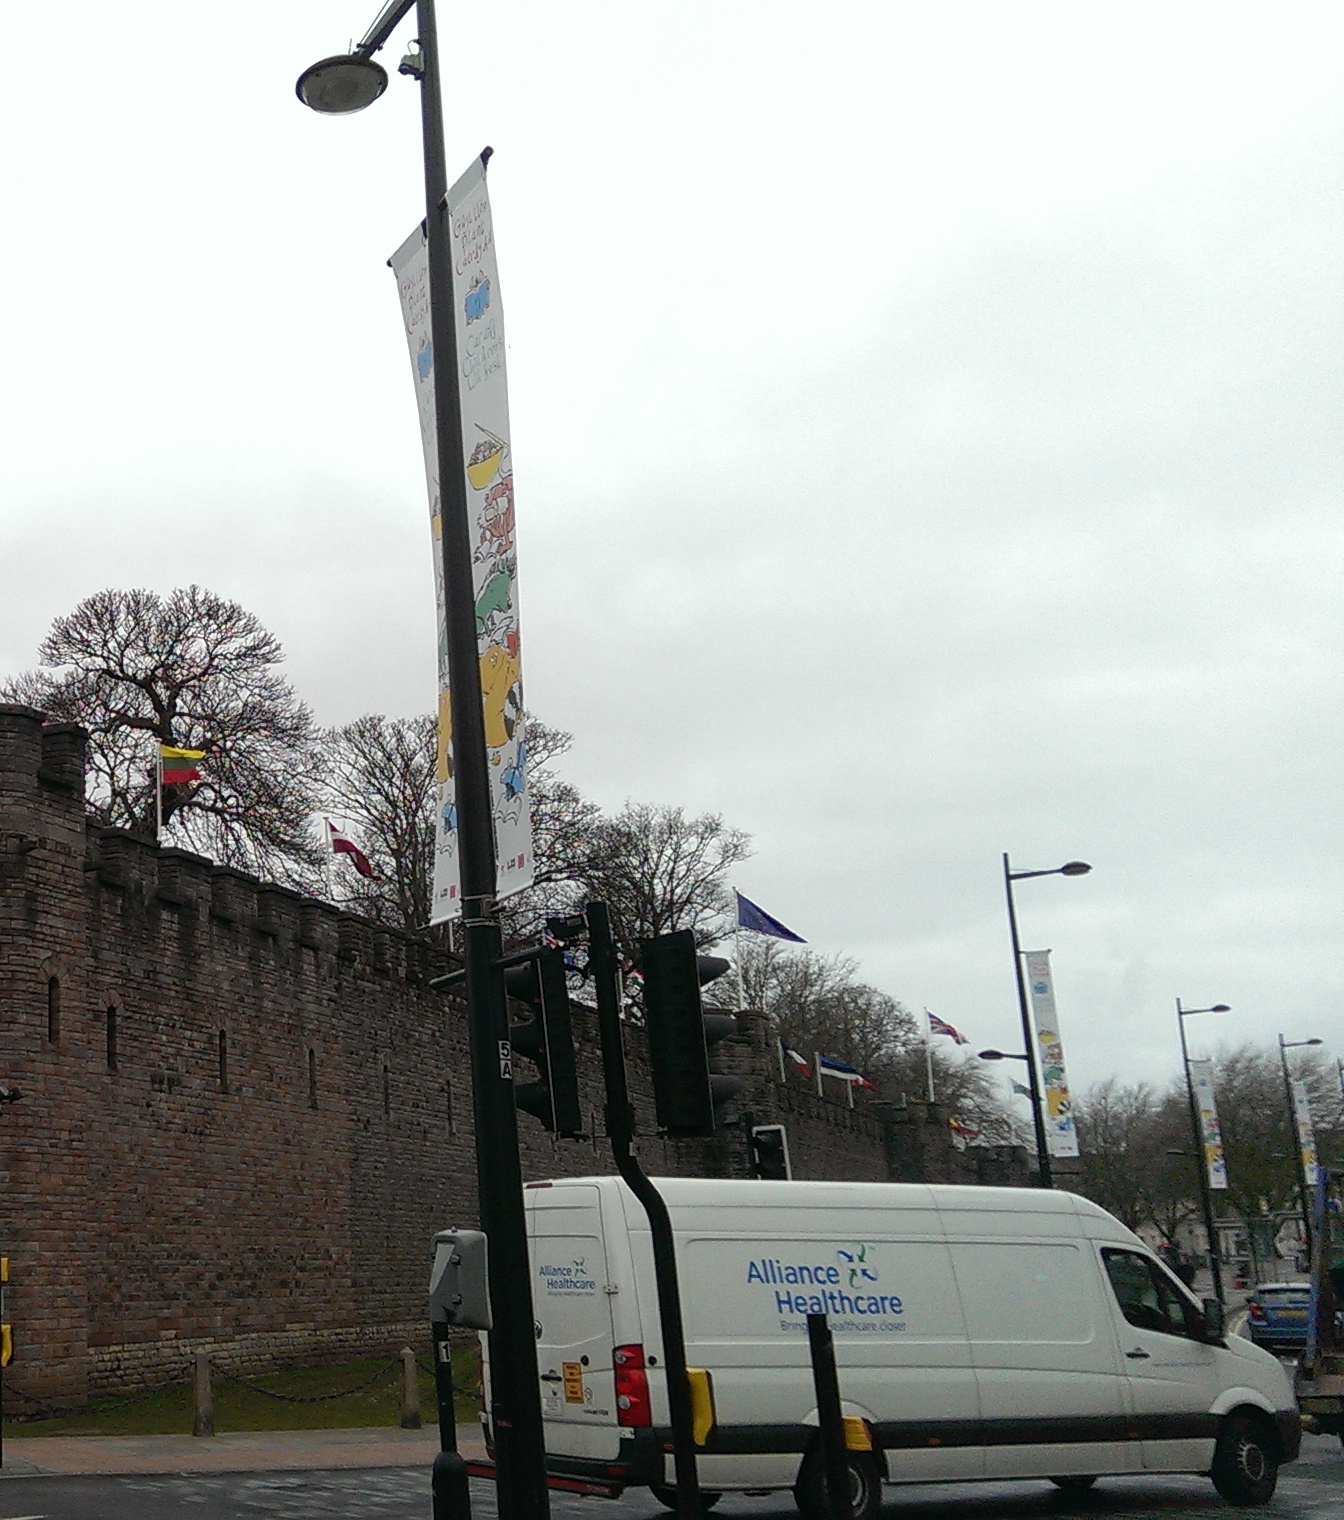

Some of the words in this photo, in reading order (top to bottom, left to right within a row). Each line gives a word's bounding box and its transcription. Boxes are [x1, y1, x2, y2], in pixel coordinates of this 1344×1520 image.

[500, 1042, 510, 1058] 5
[502, 1062, 512, 1077] A
[539, 1265, 572, 1276] Alliance
[746, 1258, 841, 1285] Alliance
[547, 1278, 595, 1289] Healthcare
[775, 1289, 904, 1315] Healthcare
[830, 1318, 878, 1332] ealthcare
[442, 1343, 450, 1361] 1
